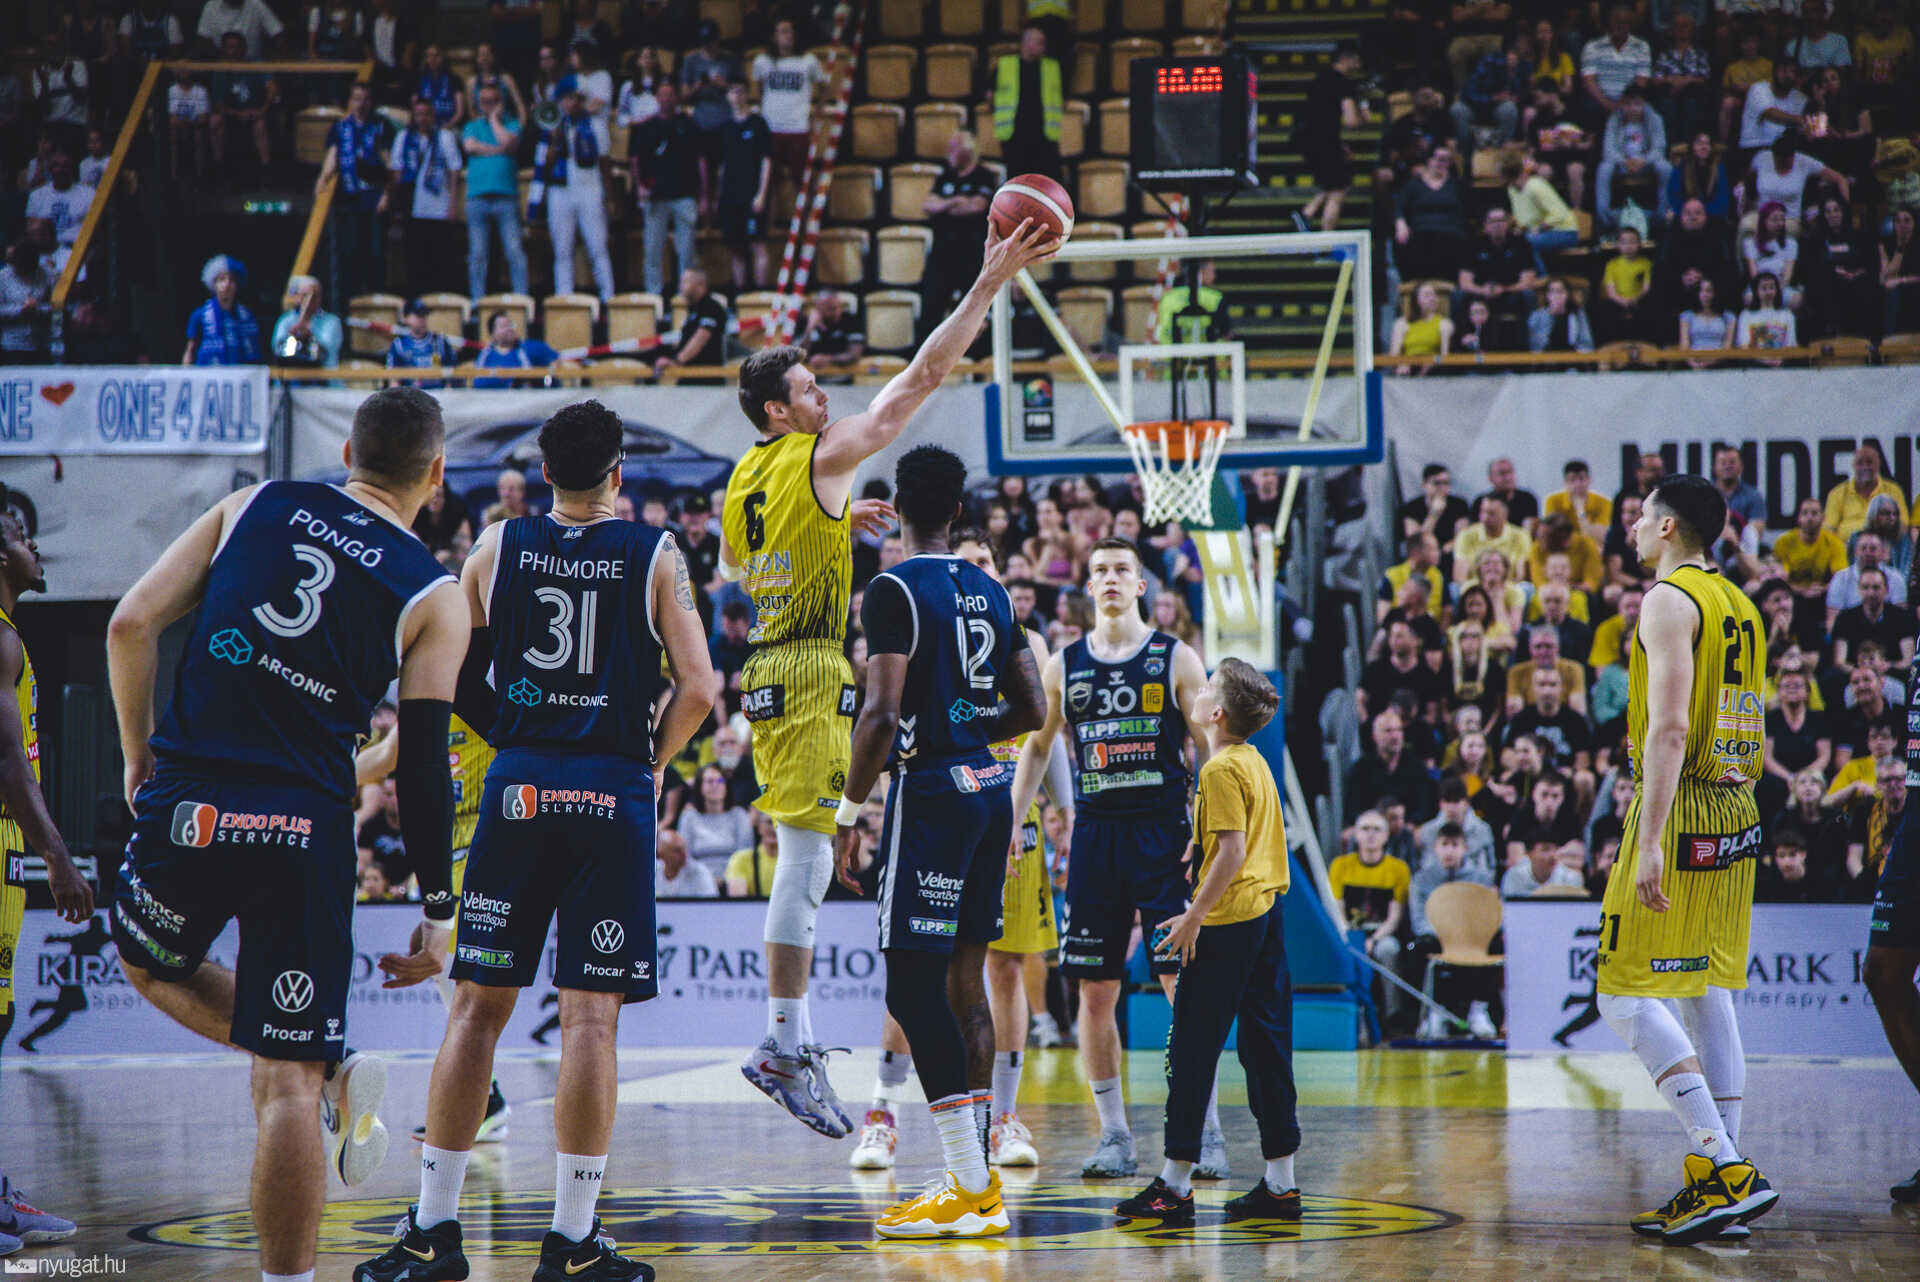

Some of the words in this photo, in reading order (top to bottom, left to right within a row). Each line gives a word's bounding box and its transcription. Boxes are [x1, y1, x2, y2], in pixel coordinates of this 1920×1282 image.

[98, 378, 167, 443] ONE
[171, 378, 194, 442] 4
[199, 378, 261, 442] ALL
[743, 490, 767, 552] 6
[288, 509, 384, 567] PONGÓ
[519, 551, 624, 579] PHILMORE
[252, 544, 336, 638] 3
[522, 587, 597, 674] 31
[955, 616, 995, 689] 12
[1722, 615, 1755, 686] 21
[257, 653, 337, 703] ARCONIC
[547, 692, 608, 706] ARCONIC
[1096, 685, 1137, 716] 30
[540, 789, 581, 802] ENDO
[582, 790, 616, 808] PLUS
[219, 812, 268, 830] ENDO
[268, 814, 313, 835] PLUS
[217, 830, 310, 849] SERVICE
[463, 890, 512, 915] Velence
[464, 911, 507, 929] resort&spa
[38, 954, 127, 986] KIRA
[584, 963, 625, 977] Procar
[689, 945, 767, 979] PAR
[811, 943, 877, 980] HO
[1746, 953, 1836, 985] ARK
[263, 1023, 314, 1041] Procar
[574, 1169, 602, 1181] K1X
